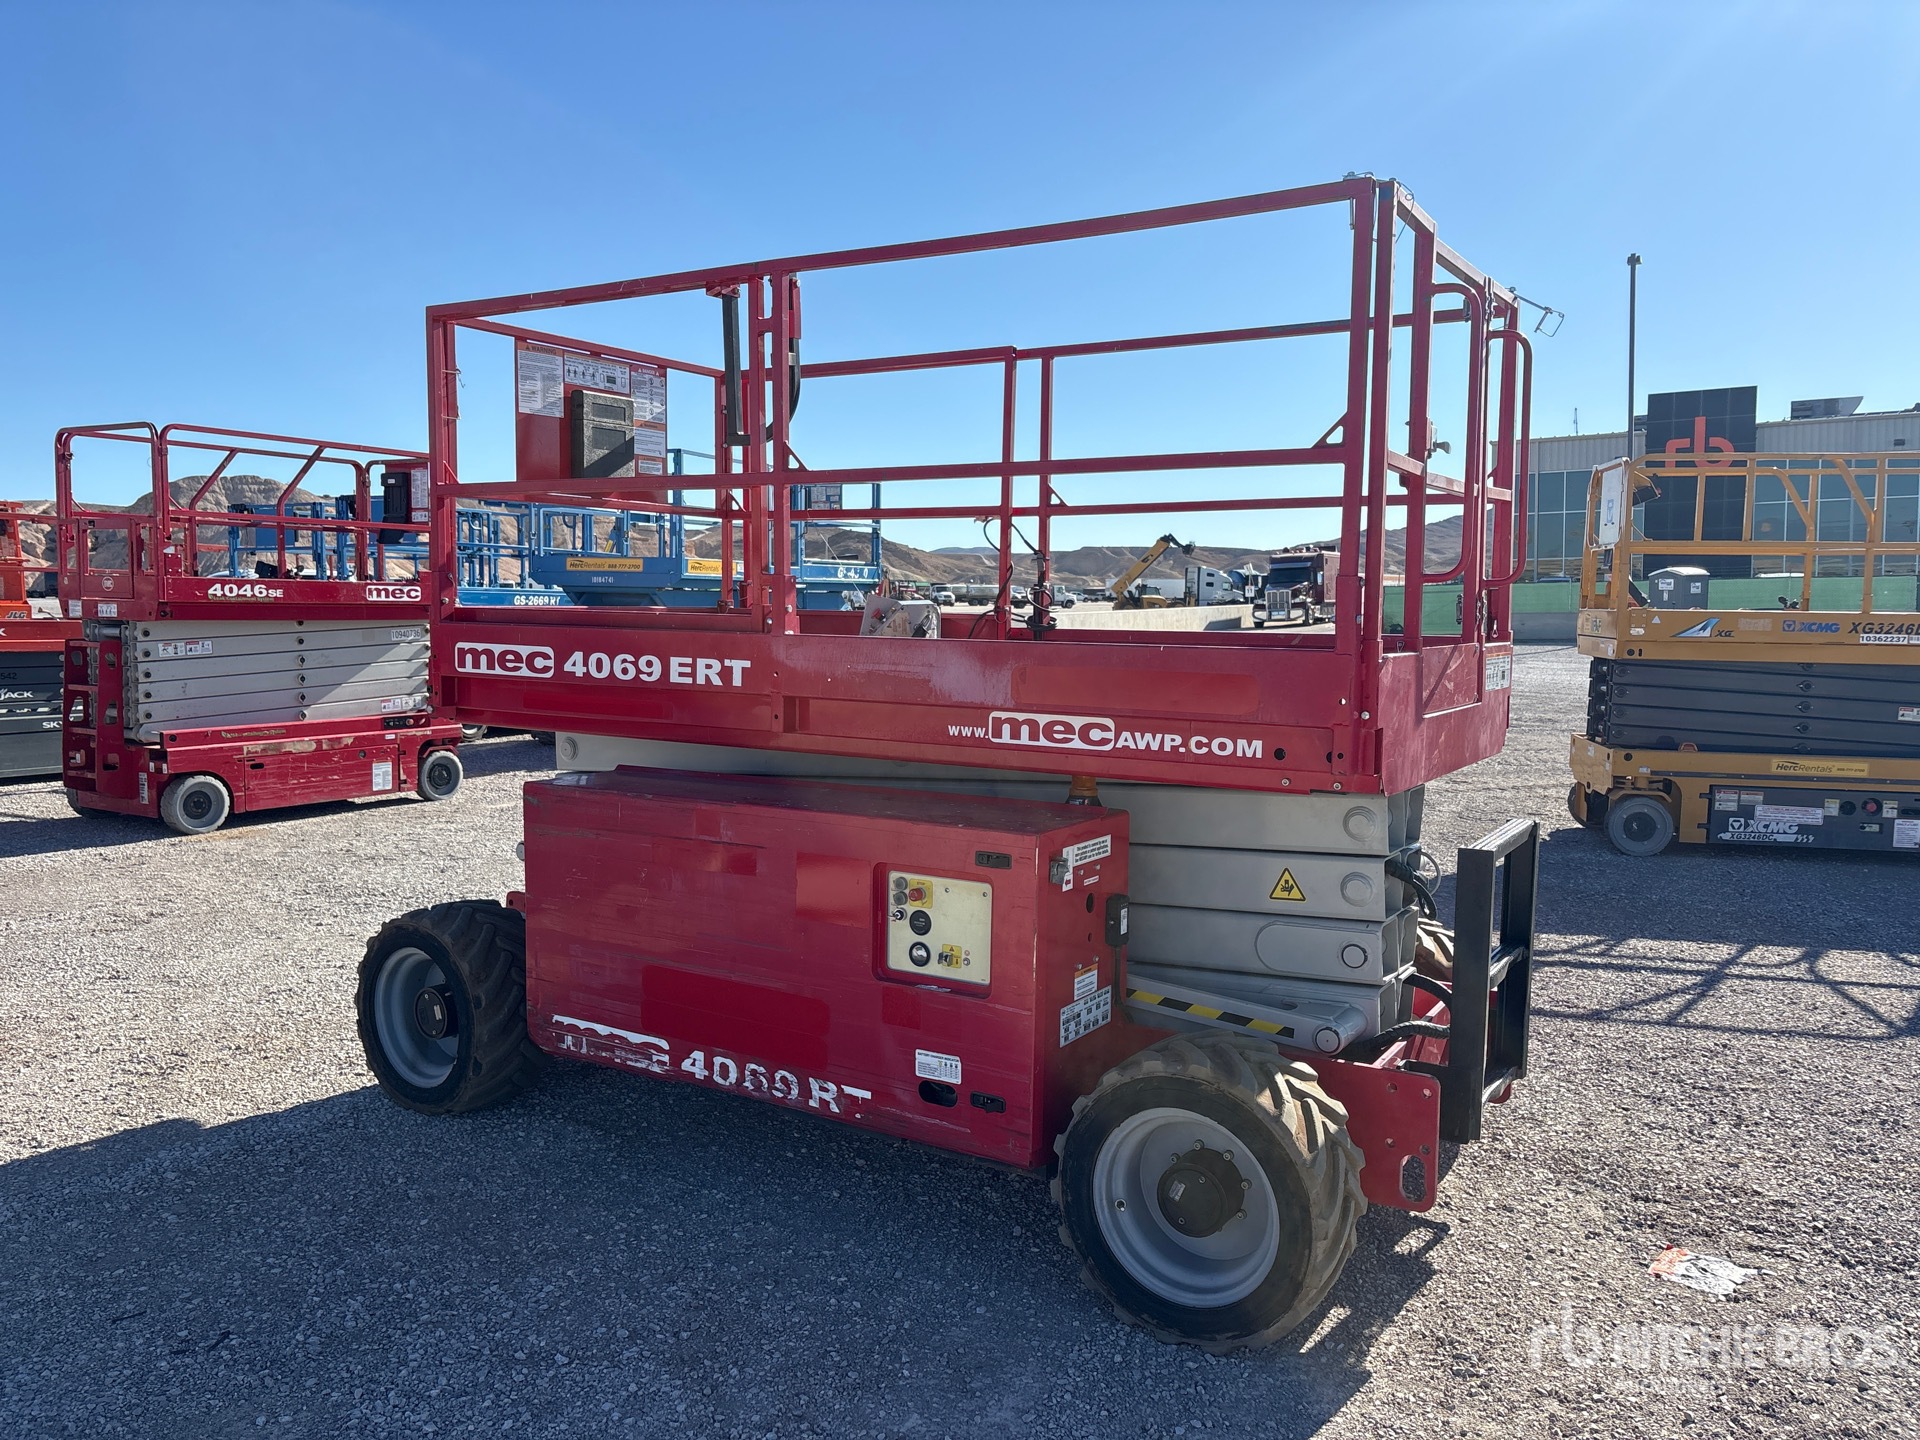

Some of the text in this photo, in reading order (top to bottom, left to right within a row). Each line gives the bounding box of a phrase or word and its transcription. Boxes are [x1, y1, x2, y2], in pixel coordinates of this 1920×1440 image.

[366, 585, 421, 601] mec
[514, 595, 549, 606] GS-2669
[1797, 622, 1841, 634] XCMG
[1860, 635, 1907, 643] 10362237
[455, 642, 750, 687] mec 4069 ERT
[1775, 761, 1833, 773] HercRentals
[1744, 819, 1800, 834] XCMG
[1729, 832, 1775, 841] XG3246DC
